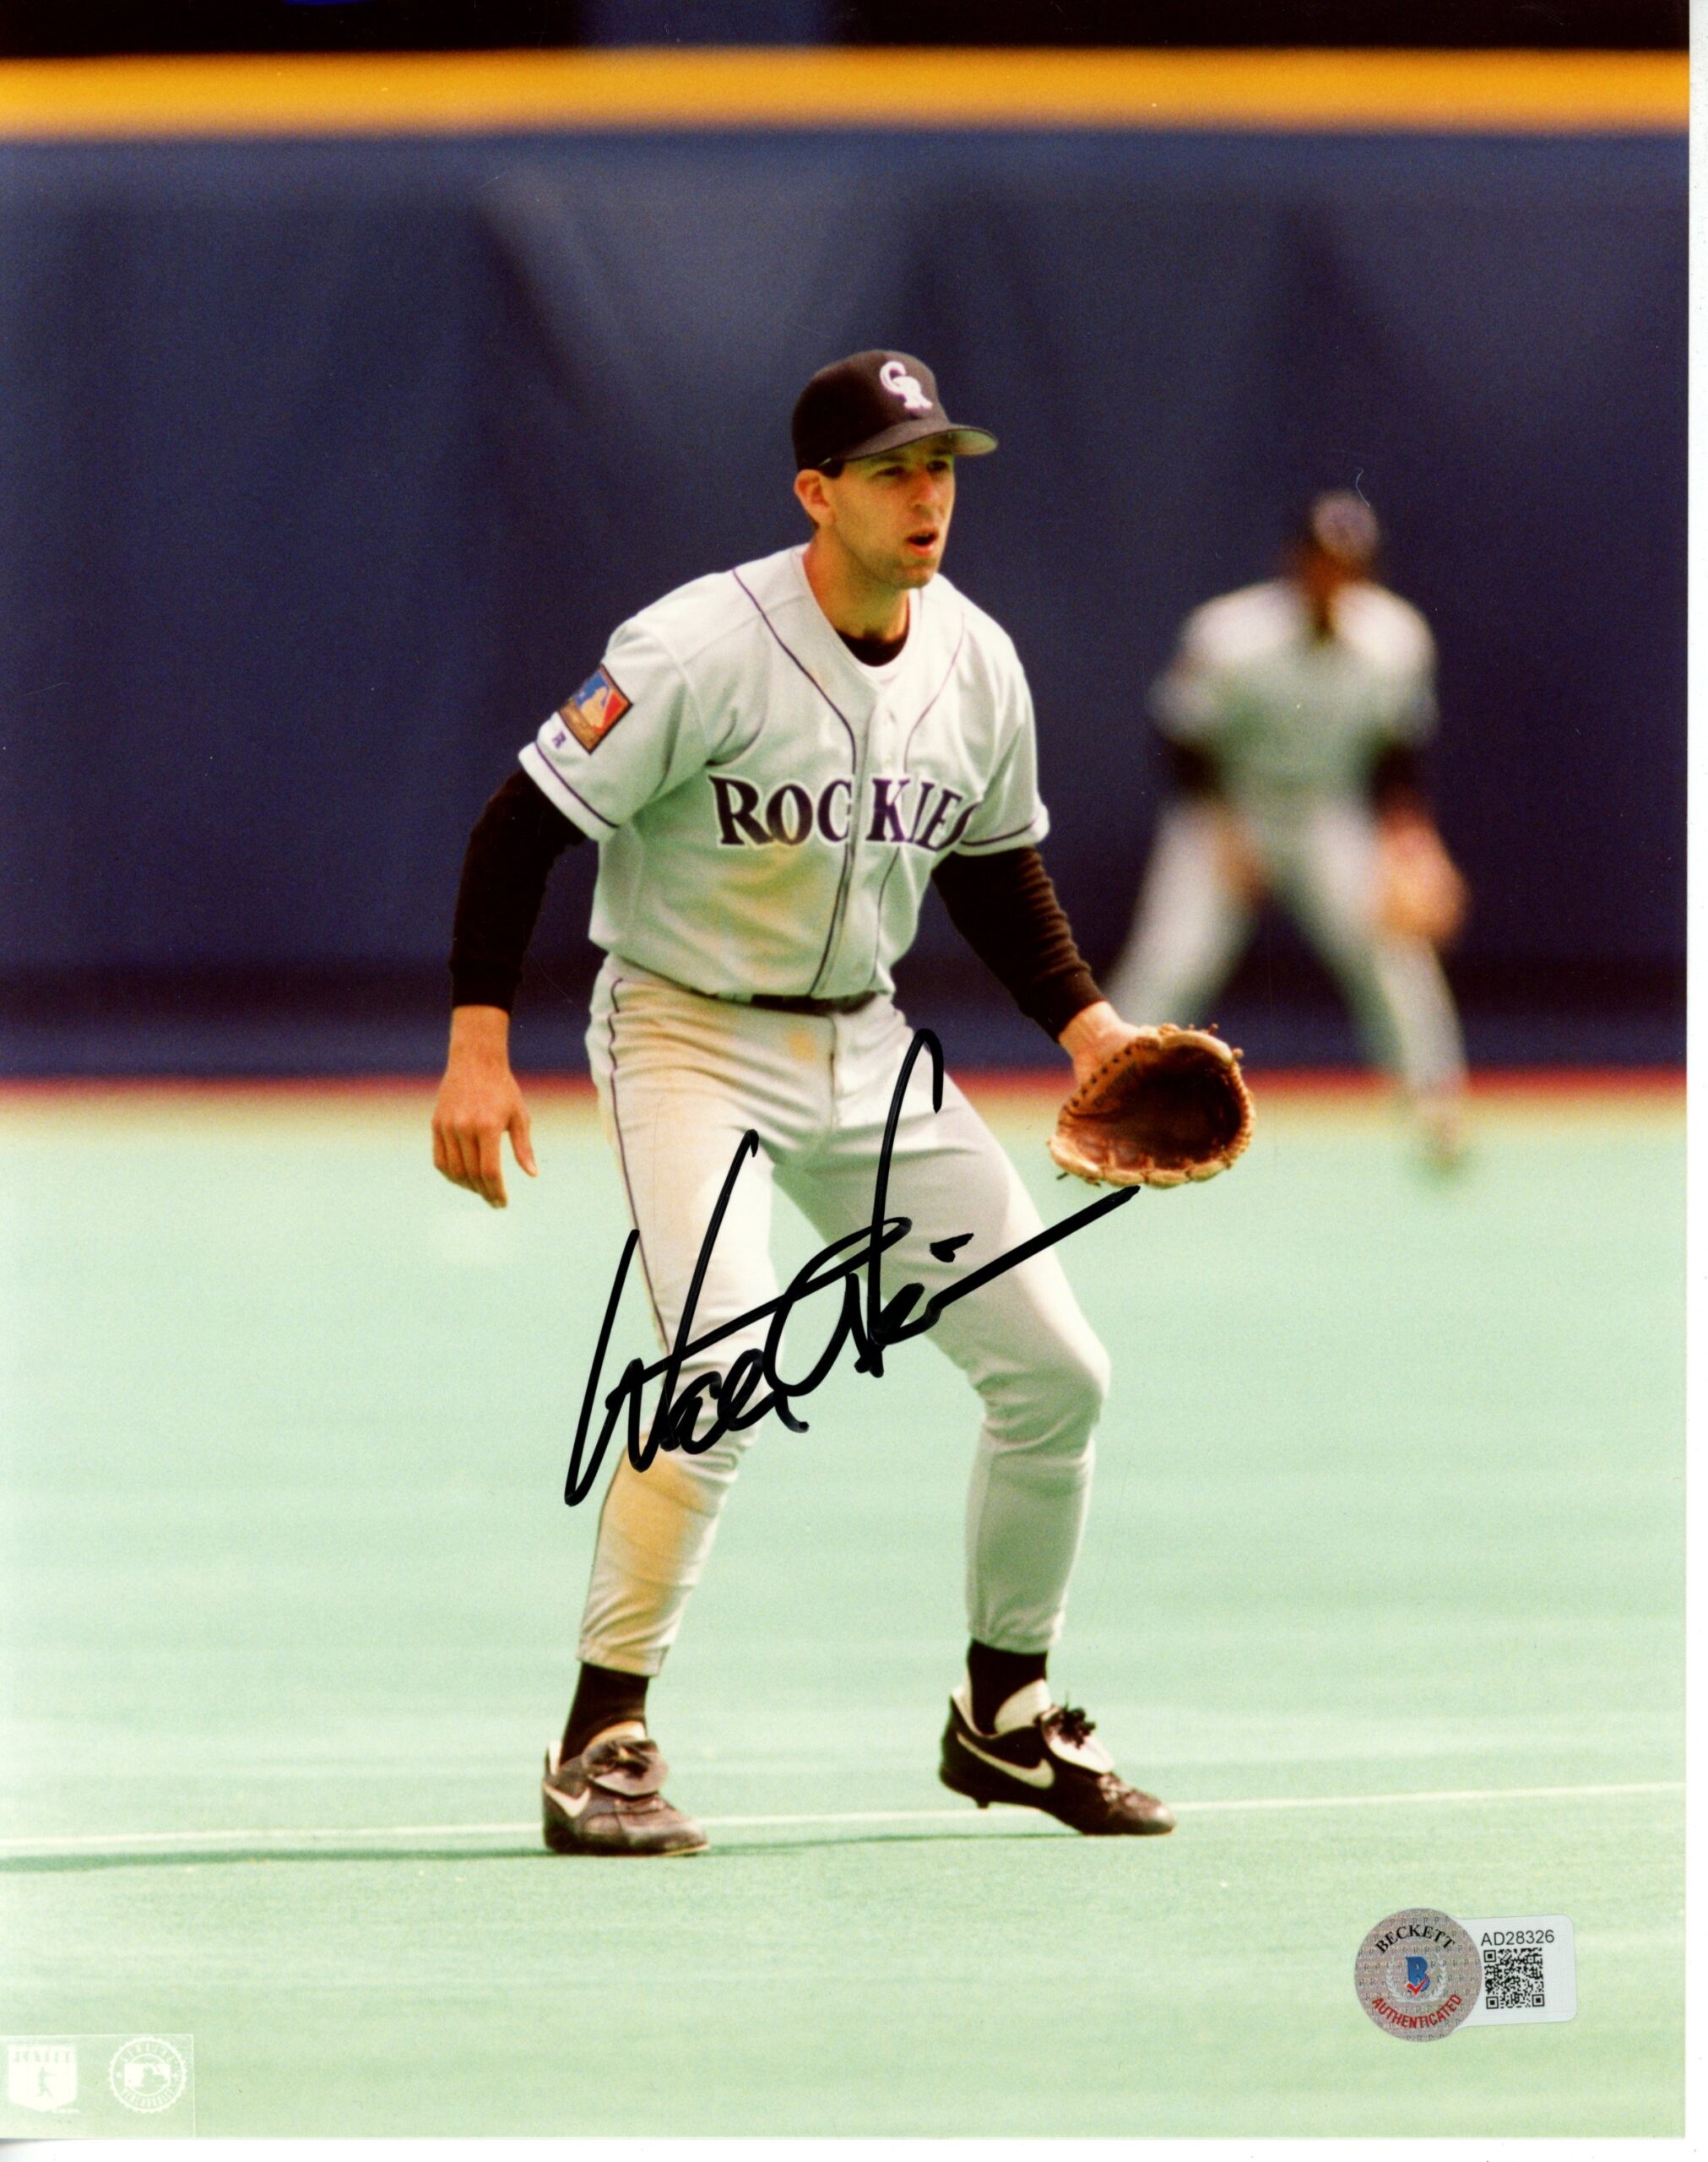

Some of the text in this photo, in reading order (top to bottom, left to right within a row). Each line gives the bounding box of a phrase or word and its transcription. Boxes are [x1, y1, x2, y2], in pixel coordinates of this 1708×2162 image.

[1375, 1924, 1456, 1954] BECKETT
[1480, 1930, 1555, 1947] AD28326
[1372, 1994, 1462, 2029] AUTHENTICATED
